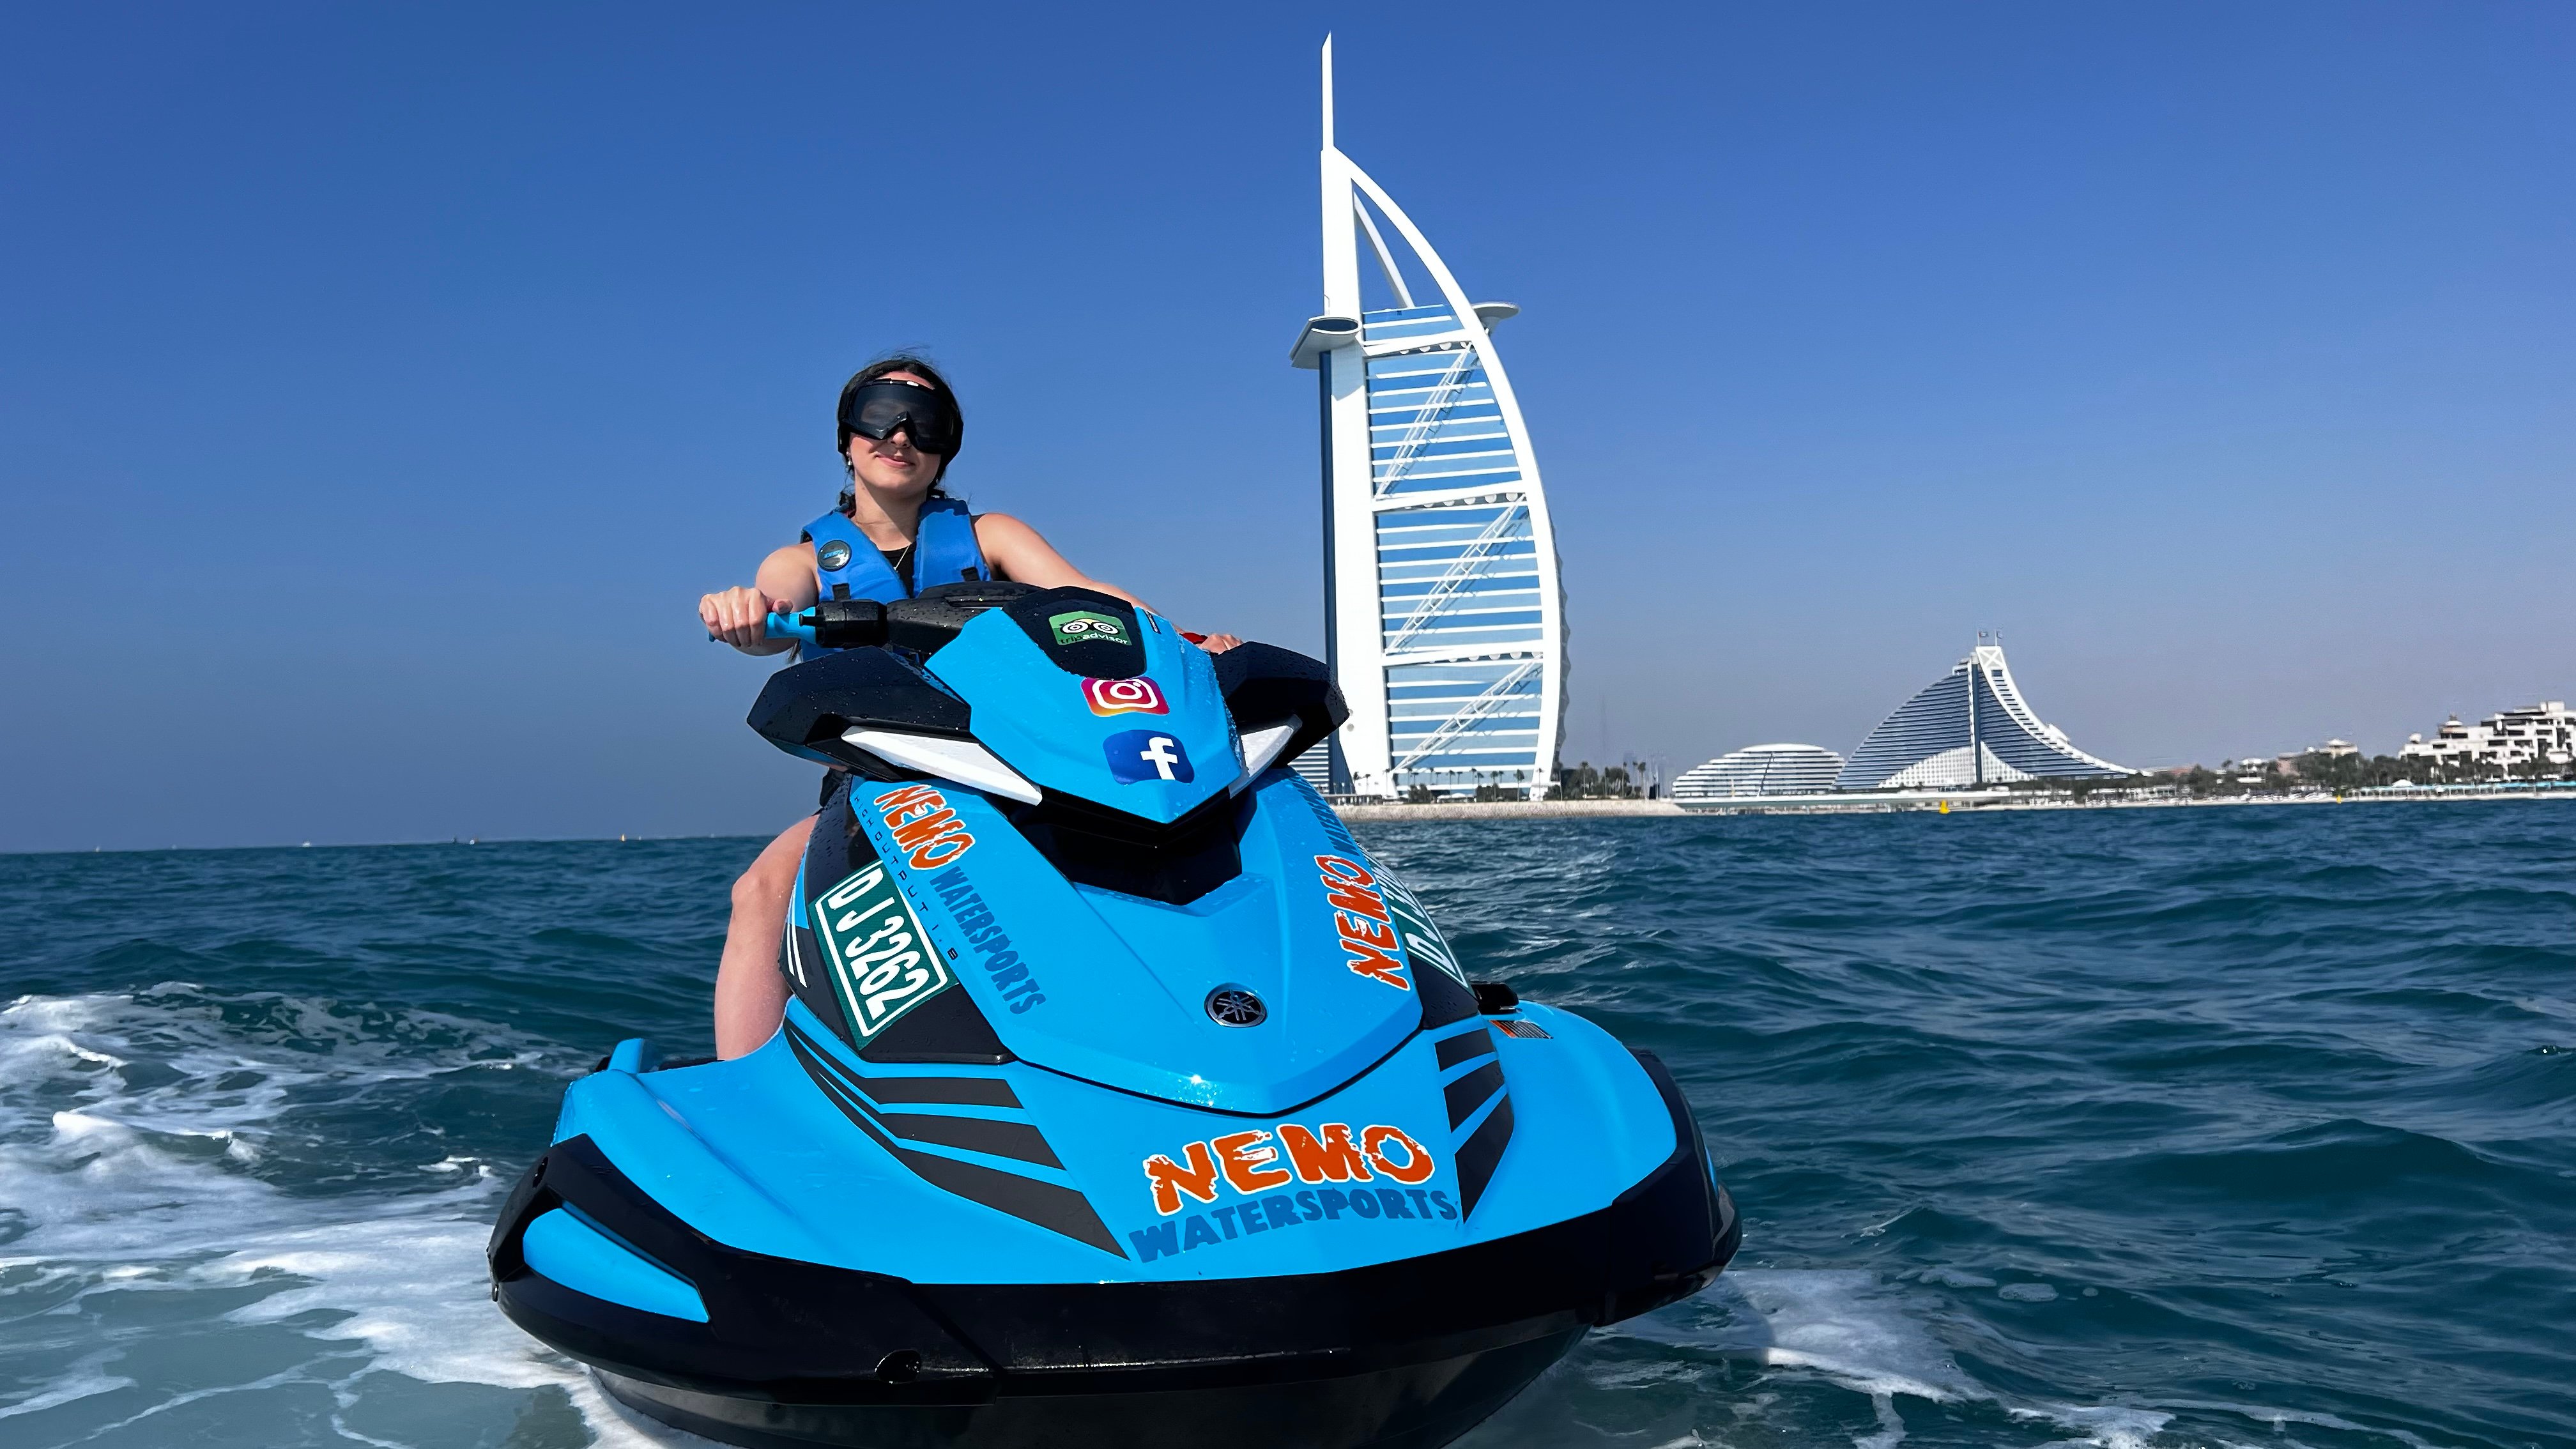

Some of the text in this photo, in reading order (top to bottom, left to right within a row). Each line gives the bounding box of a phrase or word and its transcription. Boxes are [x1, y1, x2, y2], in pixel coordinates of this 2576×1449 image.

[1060, 632, 1128, 644] tripadvisor
[854, 795, 874, 827] HIGH
[875, 831, 928, 912] OUTPUT
[873, 785, 976, 870] NEMO
[845, 916, 930, 1020] 3262
[930, 866, 1046, 1015] WATERSPORTS
[1314, 854, 1411, 992] NEMO
[1142, 1123, 1436, 1216] NEMO
[1128, 1188, 1457, 1264] WATERSPORTS
